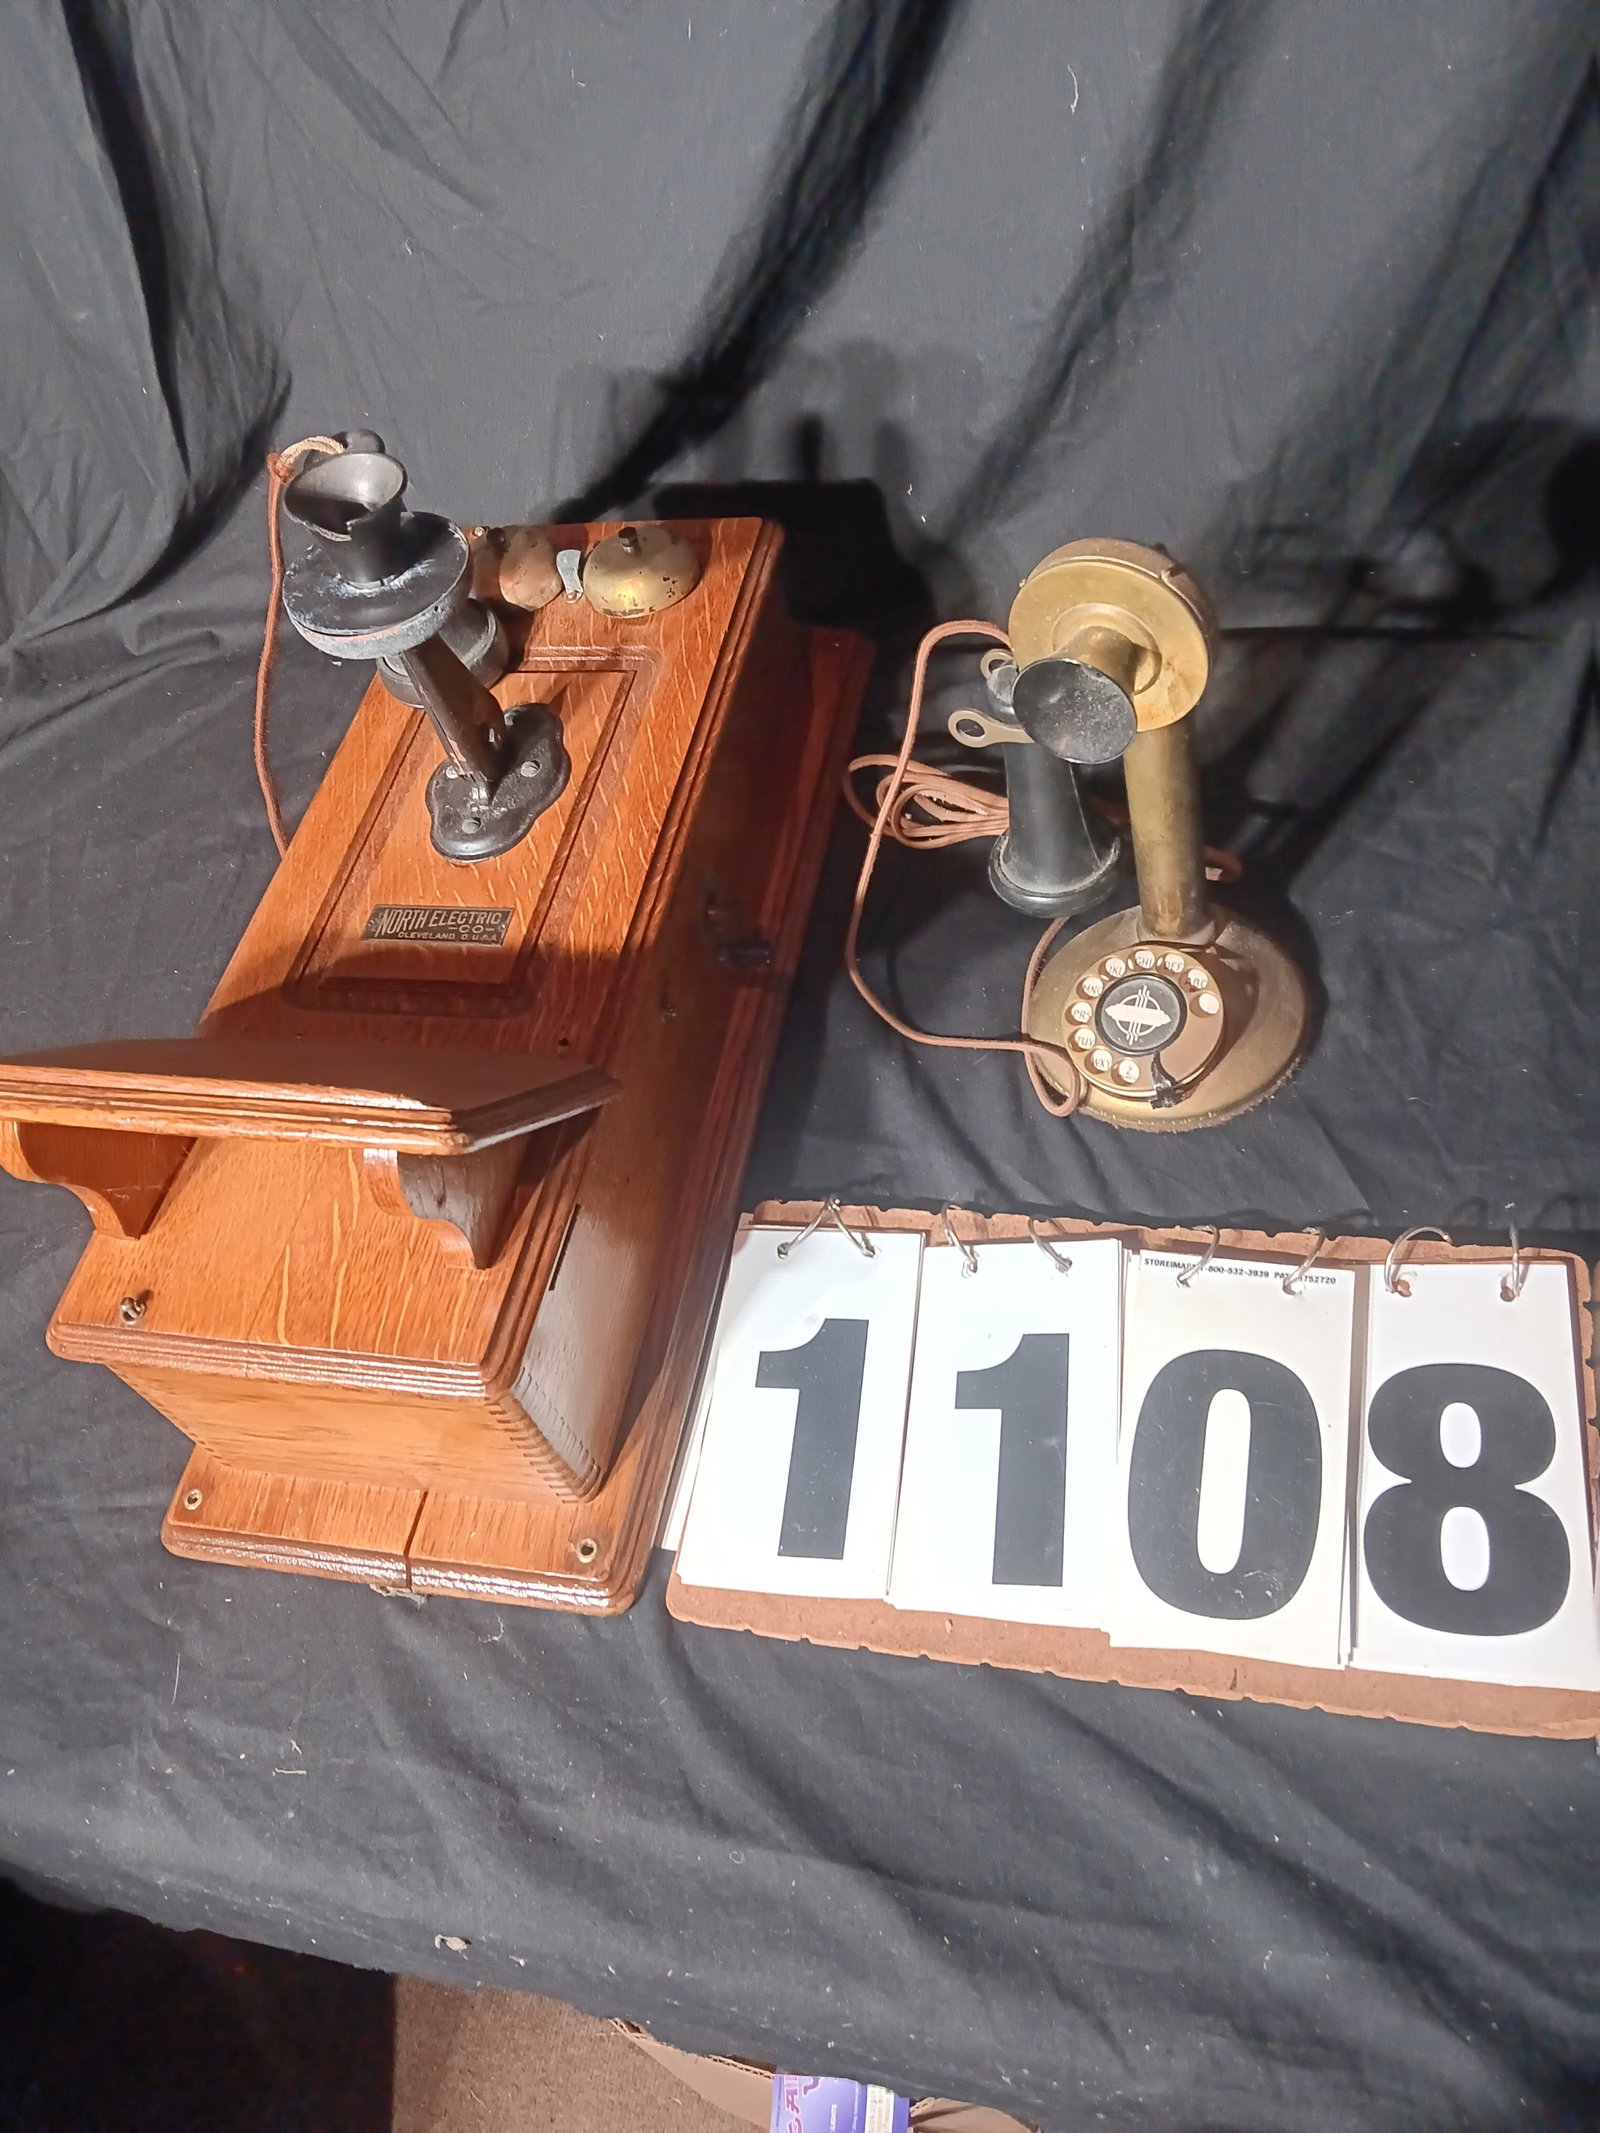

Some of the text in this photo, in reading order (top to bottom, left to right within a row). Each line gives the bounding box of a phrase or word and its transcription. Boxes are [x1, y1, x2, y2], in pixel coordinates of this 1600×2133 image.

[375, 909, 502, 938] NORTH ELECTRIC
[1144, 1257, 1198, 1272] STOREIMAG
